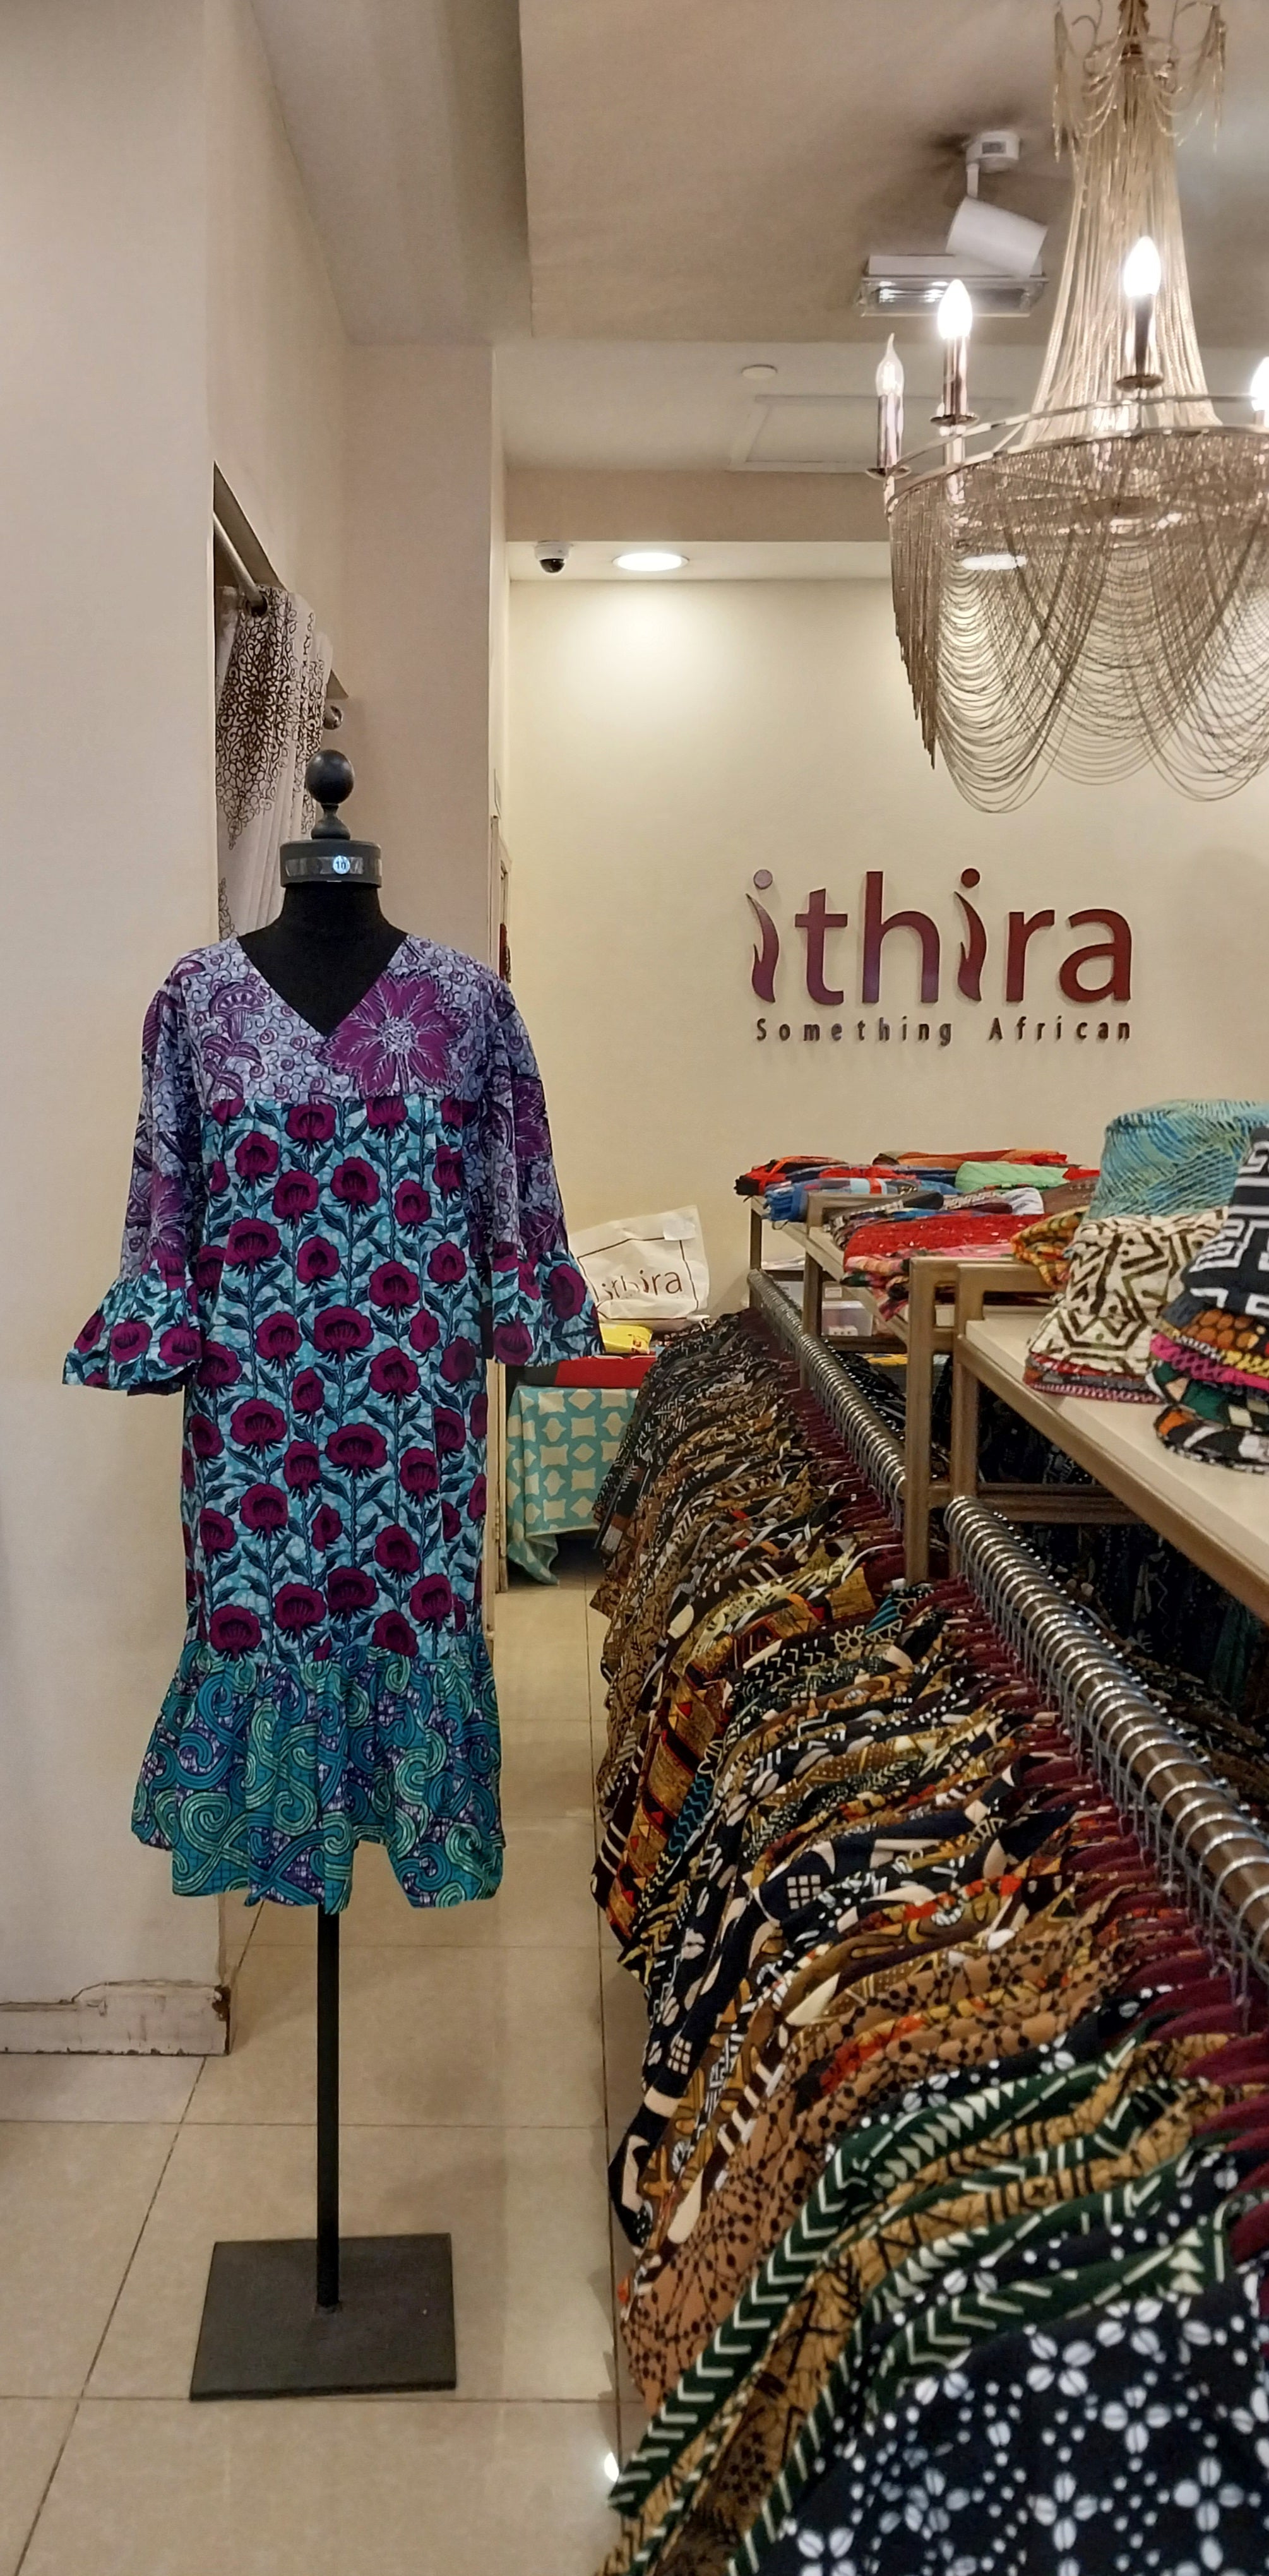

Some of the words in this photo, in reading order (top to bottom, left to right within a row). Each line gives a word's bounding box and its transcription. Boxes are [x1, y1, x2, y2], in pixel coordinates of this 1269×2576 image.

[746, 868, 1132, 1005] ithira
[756, 1017, 952, 1046] Something
[989, 1015, 1131, 1041] African
